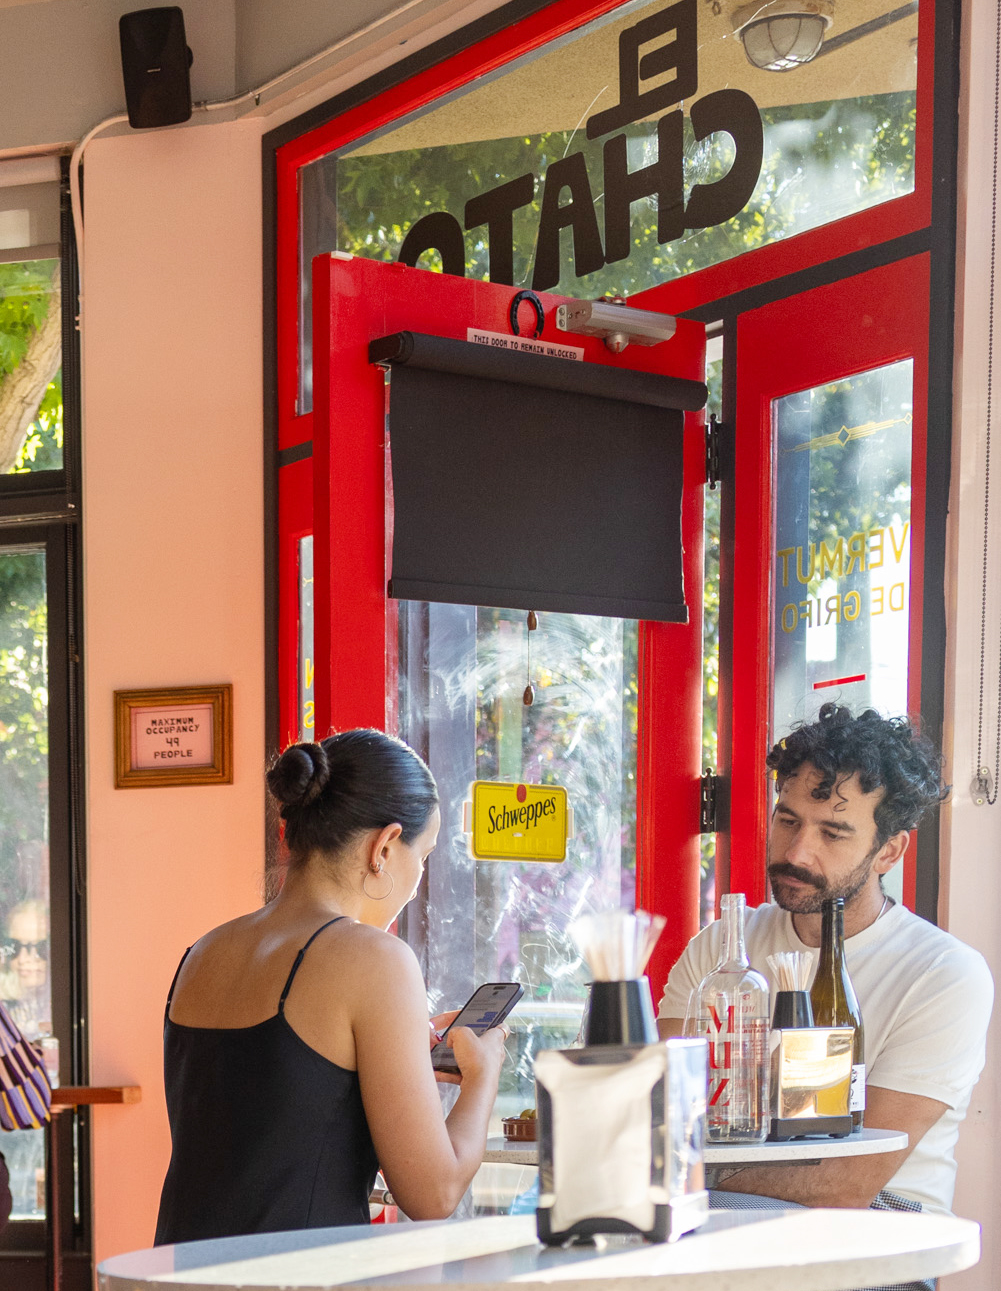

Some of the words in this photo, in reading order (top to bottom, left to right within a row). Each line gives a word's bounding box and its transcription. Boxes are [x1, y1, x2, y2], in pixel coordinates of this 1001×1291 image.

[473, 335, 489, 345] THIS
[491, 337, 508, 348] DOOR
[510, 341, 519, 350] TO
[521, 343, 545, 354] REMAIN
[547, 348, 577, 359] UNLOCKED
[151, 717, 194, 726] MAXIMUM
[146, 725, 199, 734] OCCUPANCY
[165, 737, 180, 747] 49
[153, 750, 193, 759] PEOPLE
[488, 797, 556, 834] Schweppes
